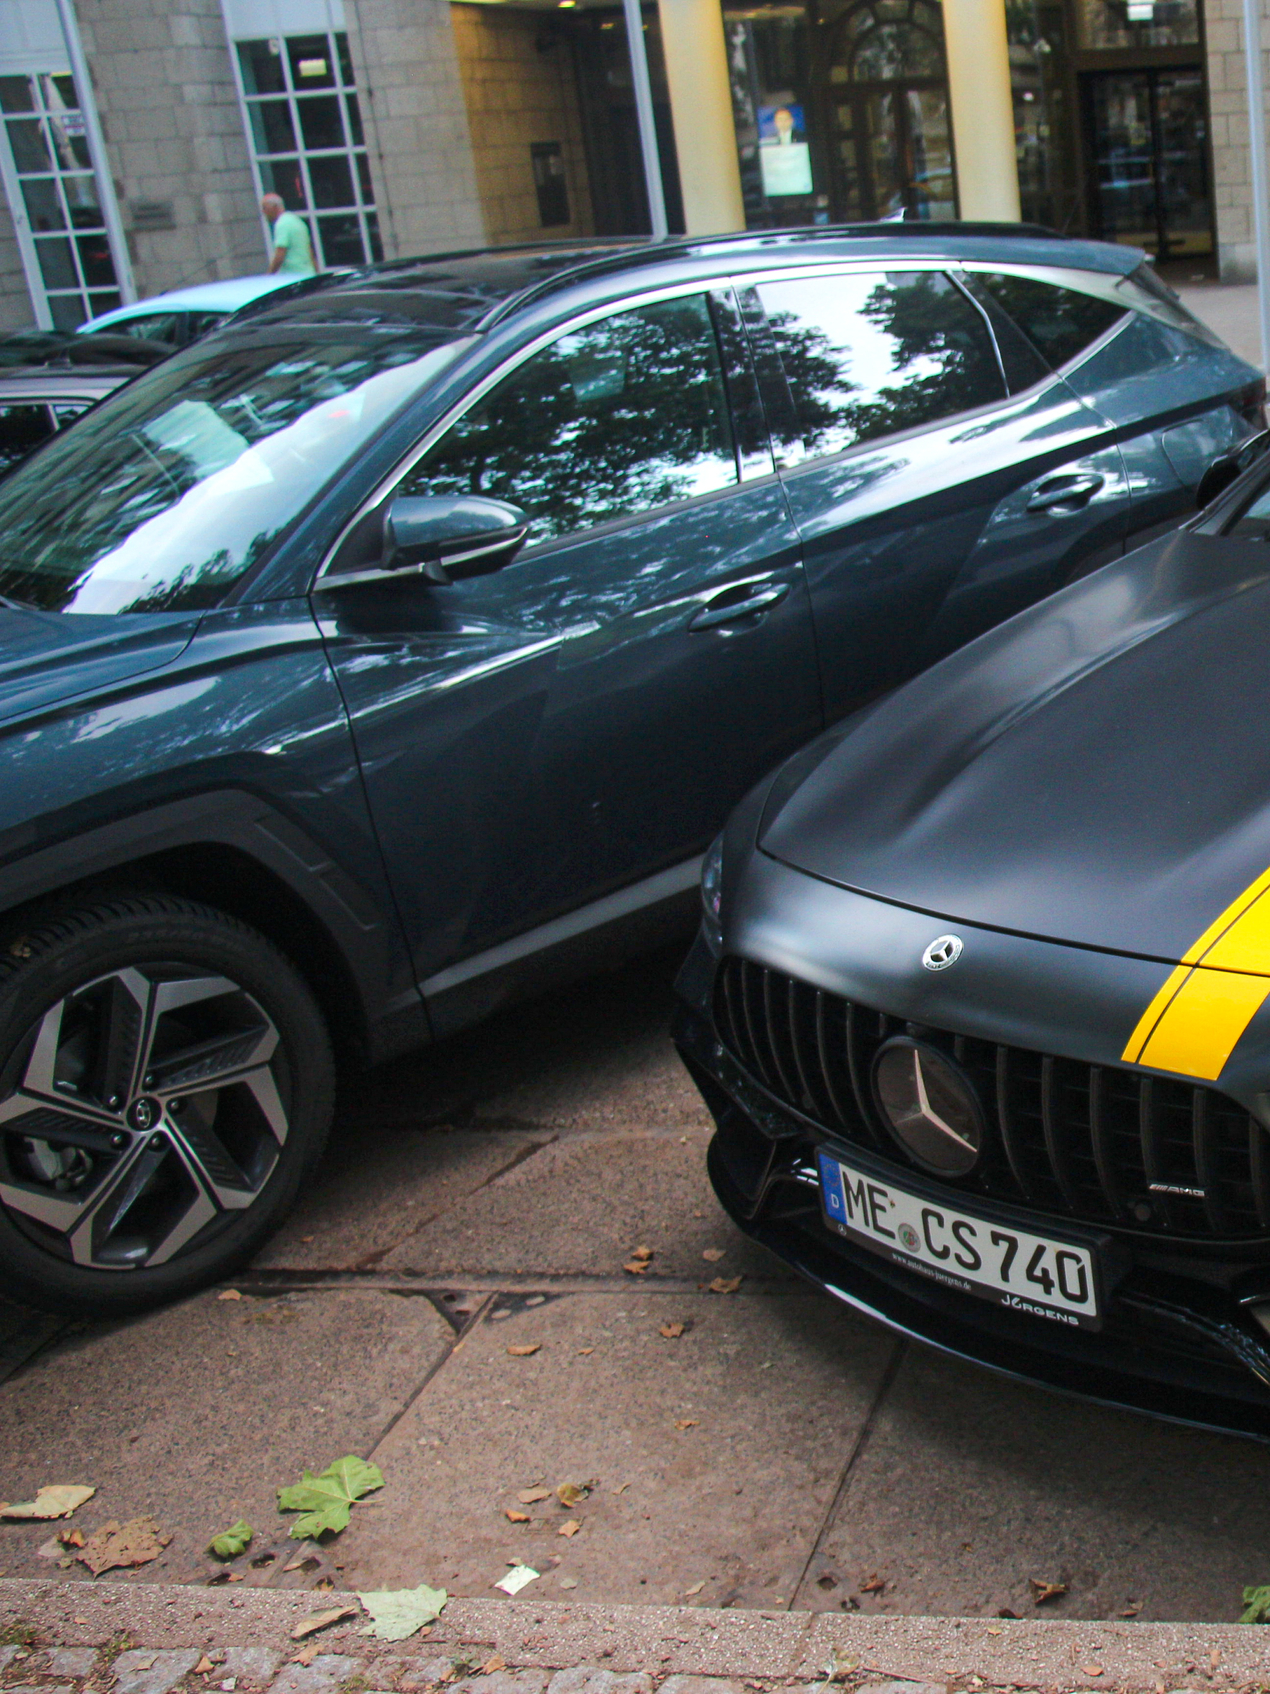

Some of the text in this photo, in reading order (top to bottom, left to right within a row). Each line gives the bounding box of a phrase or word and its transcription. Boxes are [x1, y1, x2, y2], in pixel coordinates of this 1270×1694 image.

[1166, 1185, 1205, 1197] AMG
[831, 1193, 840, 1209] D
[842, 1170, 1089, 1304] ME CS 740
